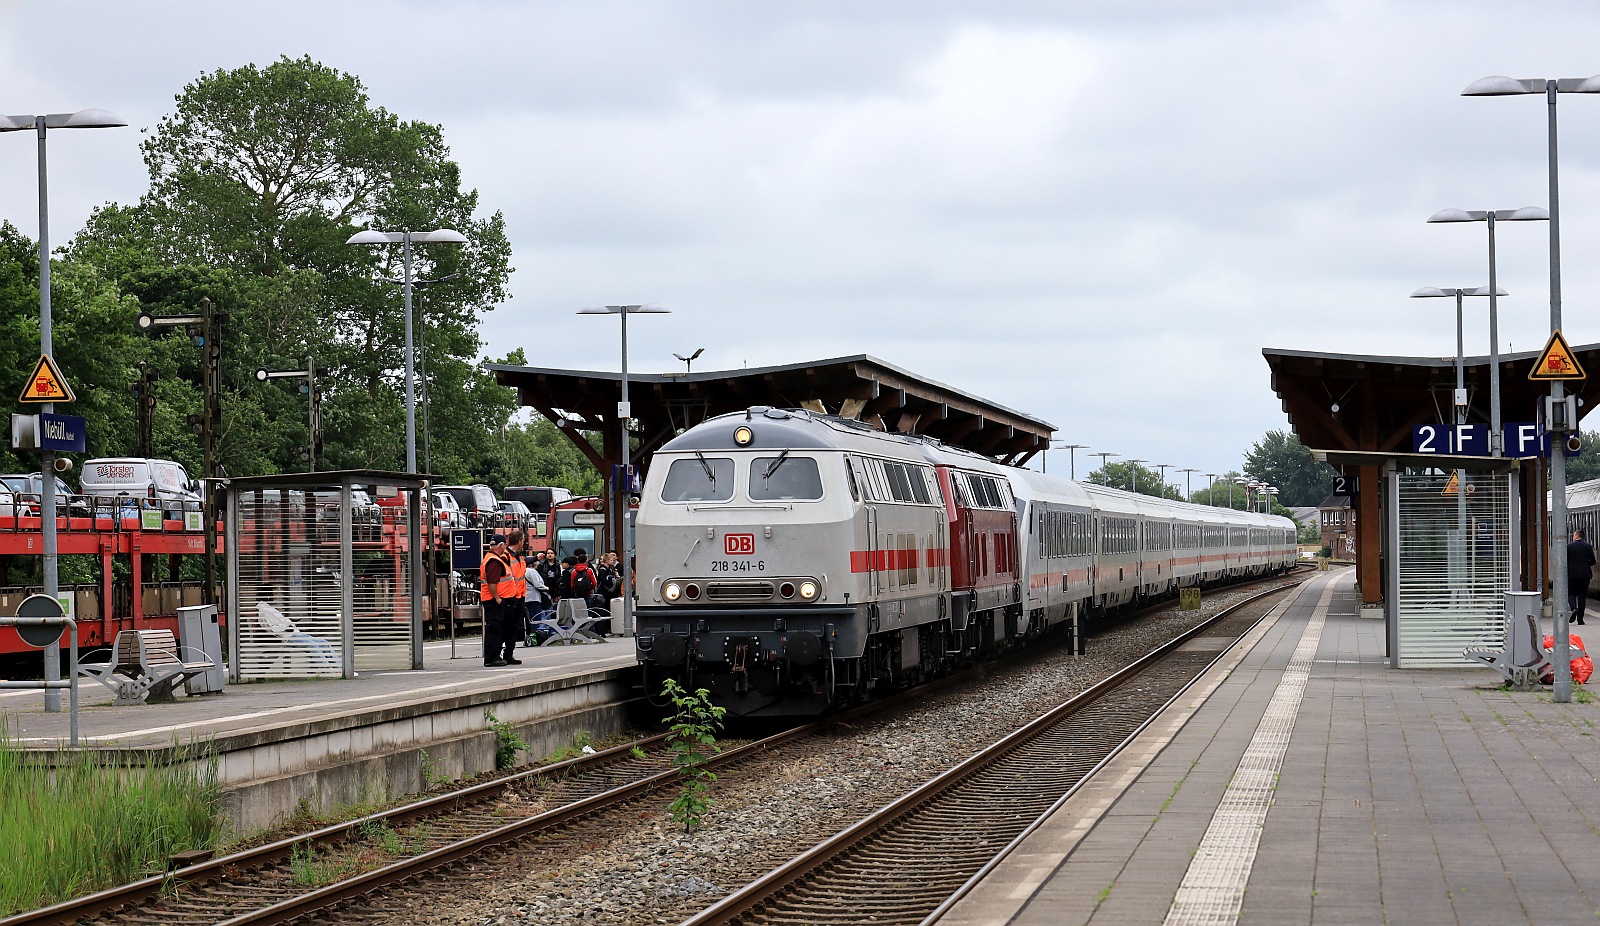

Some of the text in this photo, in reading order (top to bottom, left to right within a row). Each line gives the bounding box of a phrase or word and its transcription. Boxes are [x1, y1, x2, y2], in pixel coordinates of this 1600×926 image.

[44, 419, 66, 440] Niebüll
[1418, 425, 1436, 453] 2
[1456, 424, 1474, 452] F
[1518, 425, 1536, 453] F
[108, 465, 135, 473] Torsten
[1335, 477, 1346, 492] 2
[727, 536, 752, 552] DB
[711, 560, 765, 572] 218 341-6
[1181, 589, 1200, 599] 198
